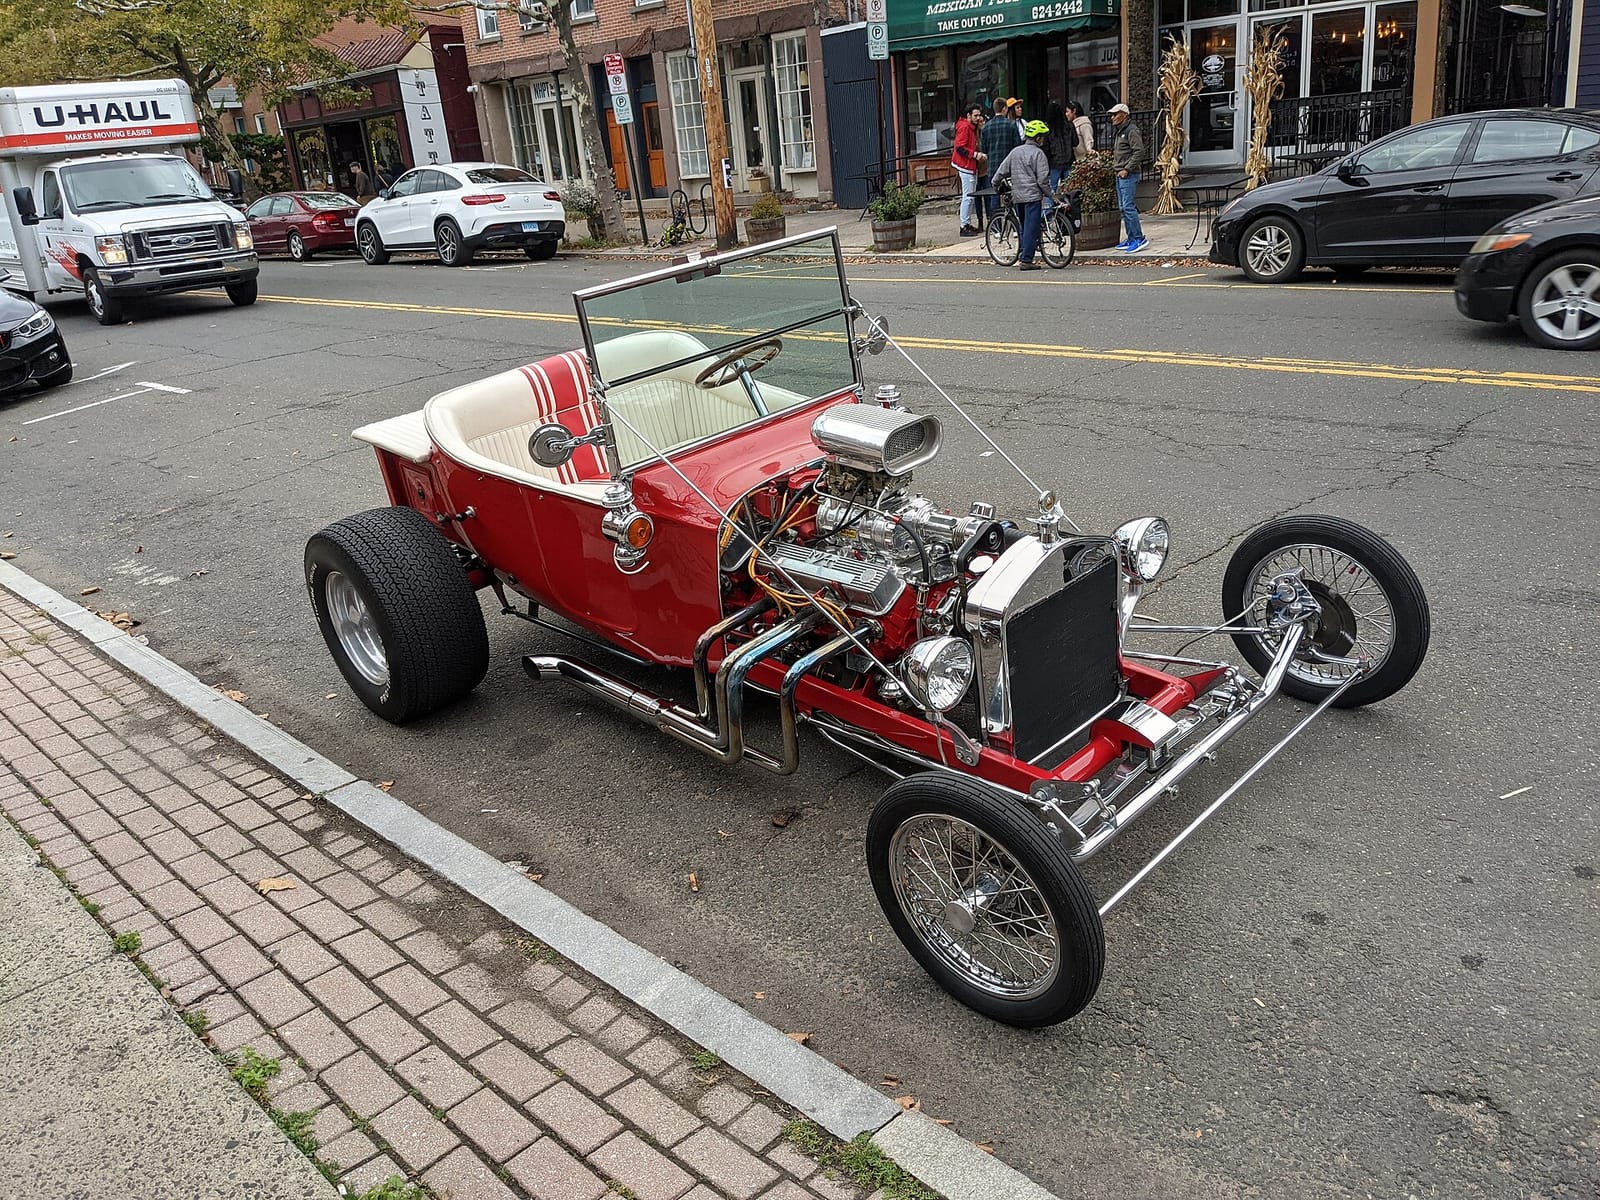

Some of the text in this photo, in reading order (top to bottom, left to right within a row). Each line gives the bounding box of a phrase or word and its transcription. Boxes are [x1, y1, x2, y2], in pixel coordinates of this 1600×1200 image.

[926, 0, 983, 15] MEXICAN
[1032, 0, 1083, 20] 624-2442
[937, 14, 1004, 32] TAKE OUT FOOD
[33, 100, 171, 127] U-HAUL
[65, 129, 153, 142] MAKES MOVING EASIER
